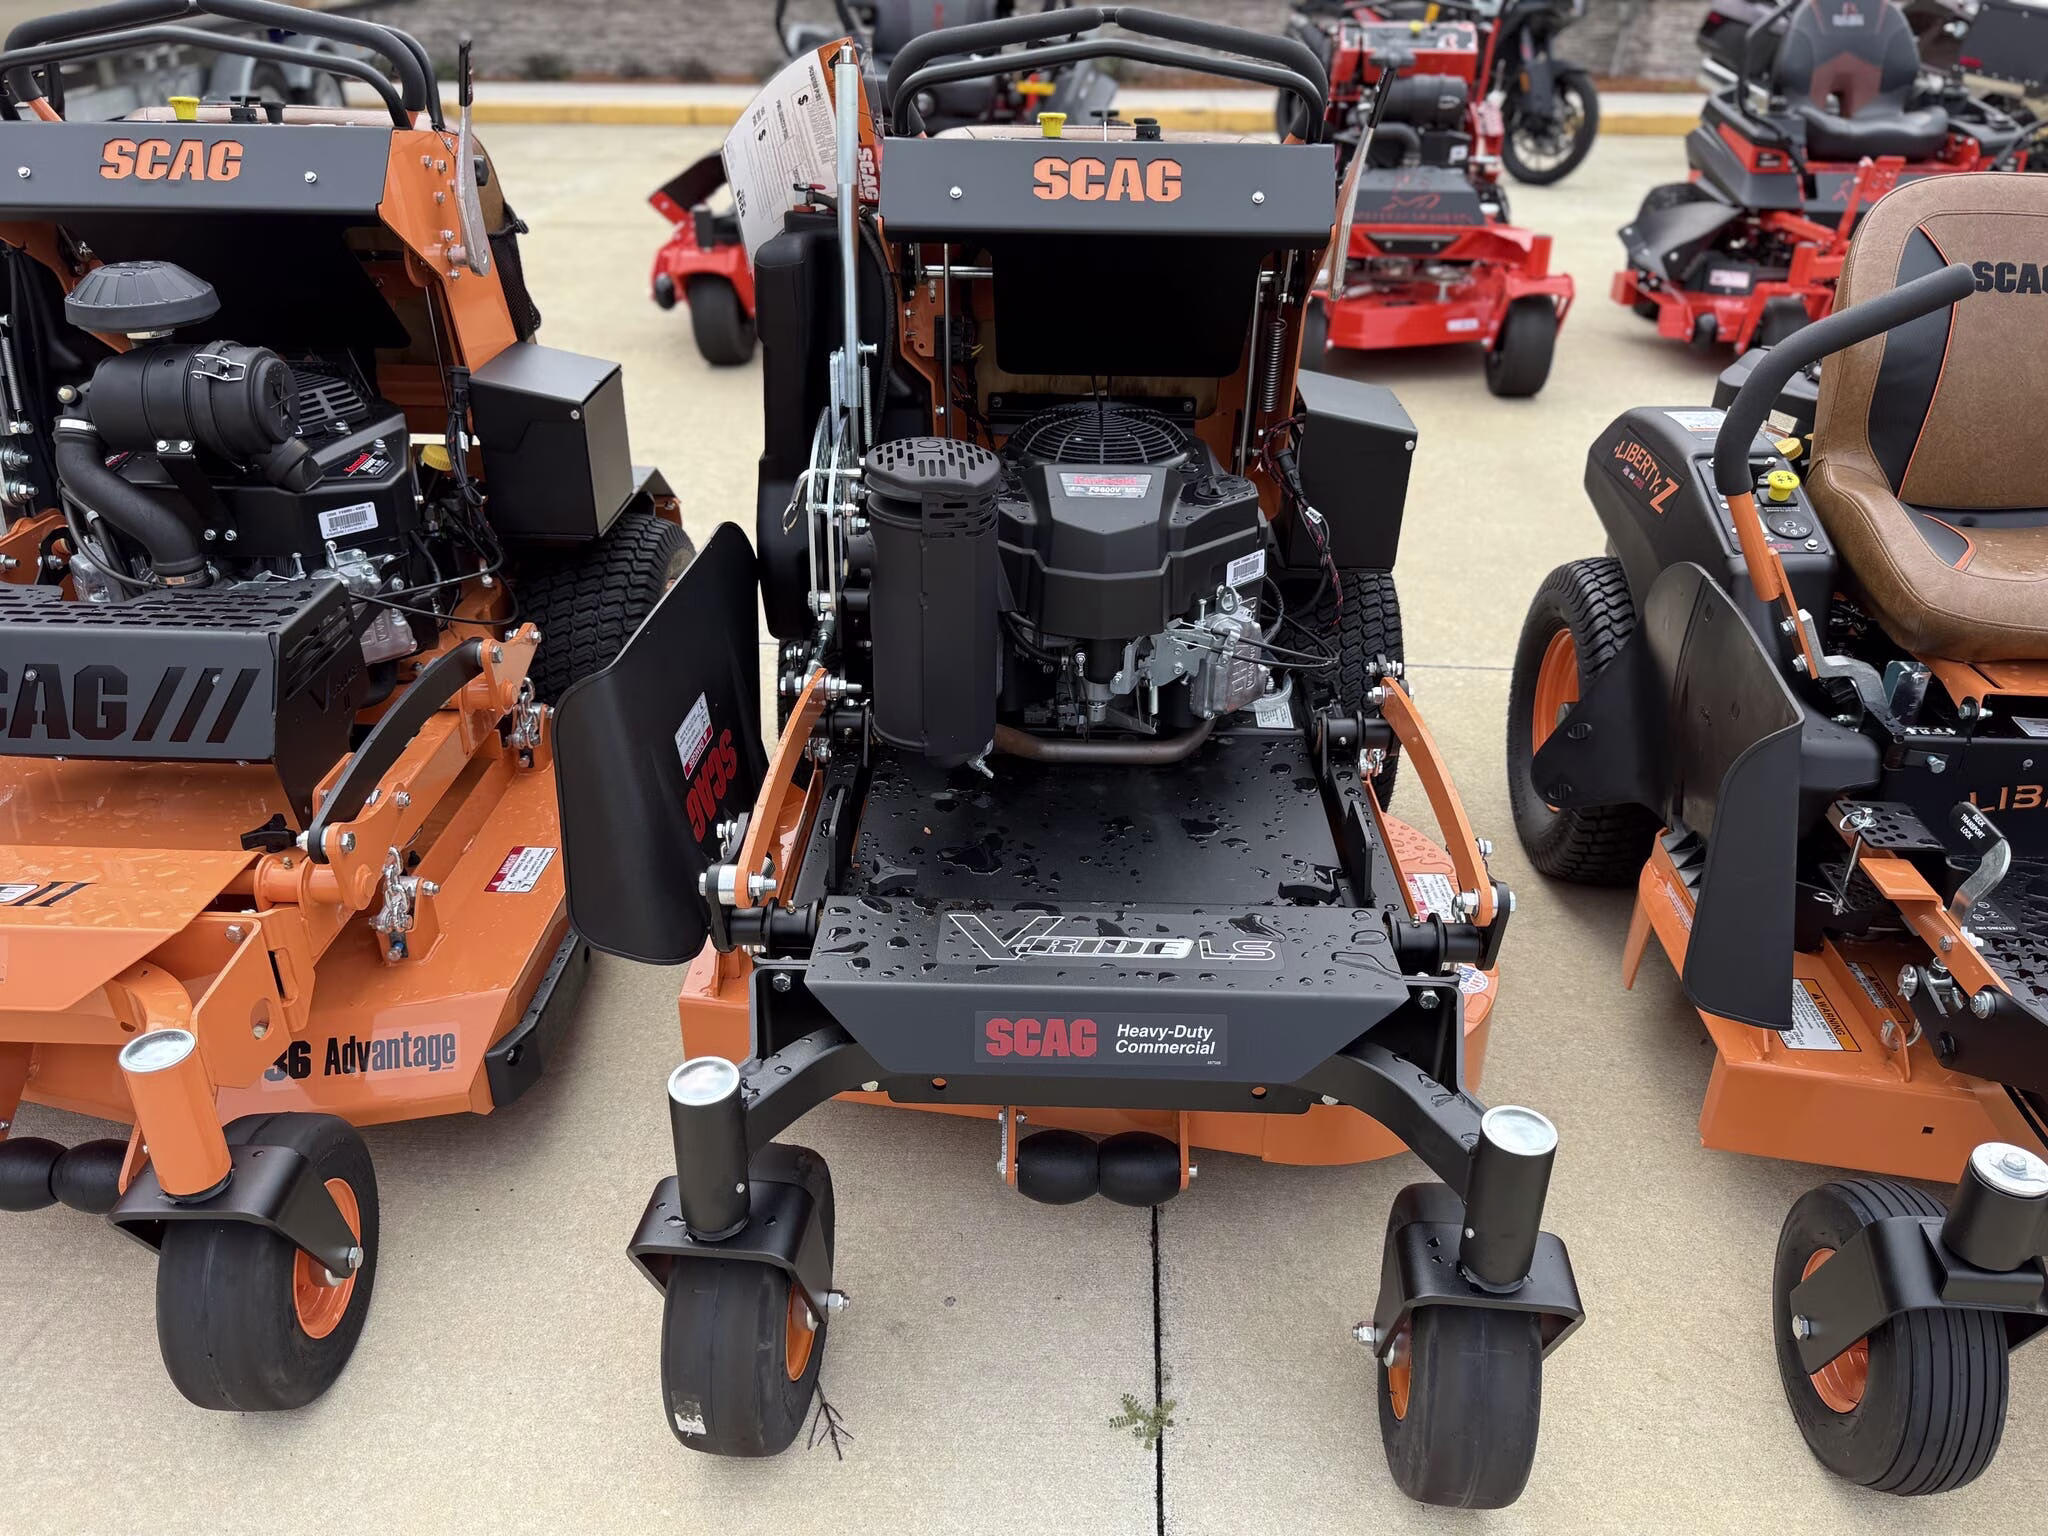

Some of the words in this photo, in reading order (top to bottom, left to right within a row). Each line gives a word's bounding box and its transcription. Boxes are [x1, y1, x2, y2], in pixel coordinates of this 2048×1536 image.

[99, 138, 244, 182] SCAG
[857, 147, 880, 201] SCAG
[1033, 156, 1182, 202] SCAG
[1972, 261, 2048, 294] SCA
[1615, 440, 1662, 491] LIBERTY
[1649, 477, 1680, 514] Z
[686, 728, 738, 843] SCAG
[1968, 784, 2048, 812] LIB
[1960, 813, 1986, 839] TRANSPORT
[1960, 825, 1974, 840] LOCK
[1972, 813, 1986, 828] DECK
[1199, 939, 1277, 961] LS
[1117, 1024, 1213, 1042] Heavy-Duty
[1816, 1001, 1846, 1035] WARNING
[324, 1031, 456, 1076] Advantage
[985, 1018, 1098, 1058] SCAG
[1115, 1040, 1216, 1056] Commercial
